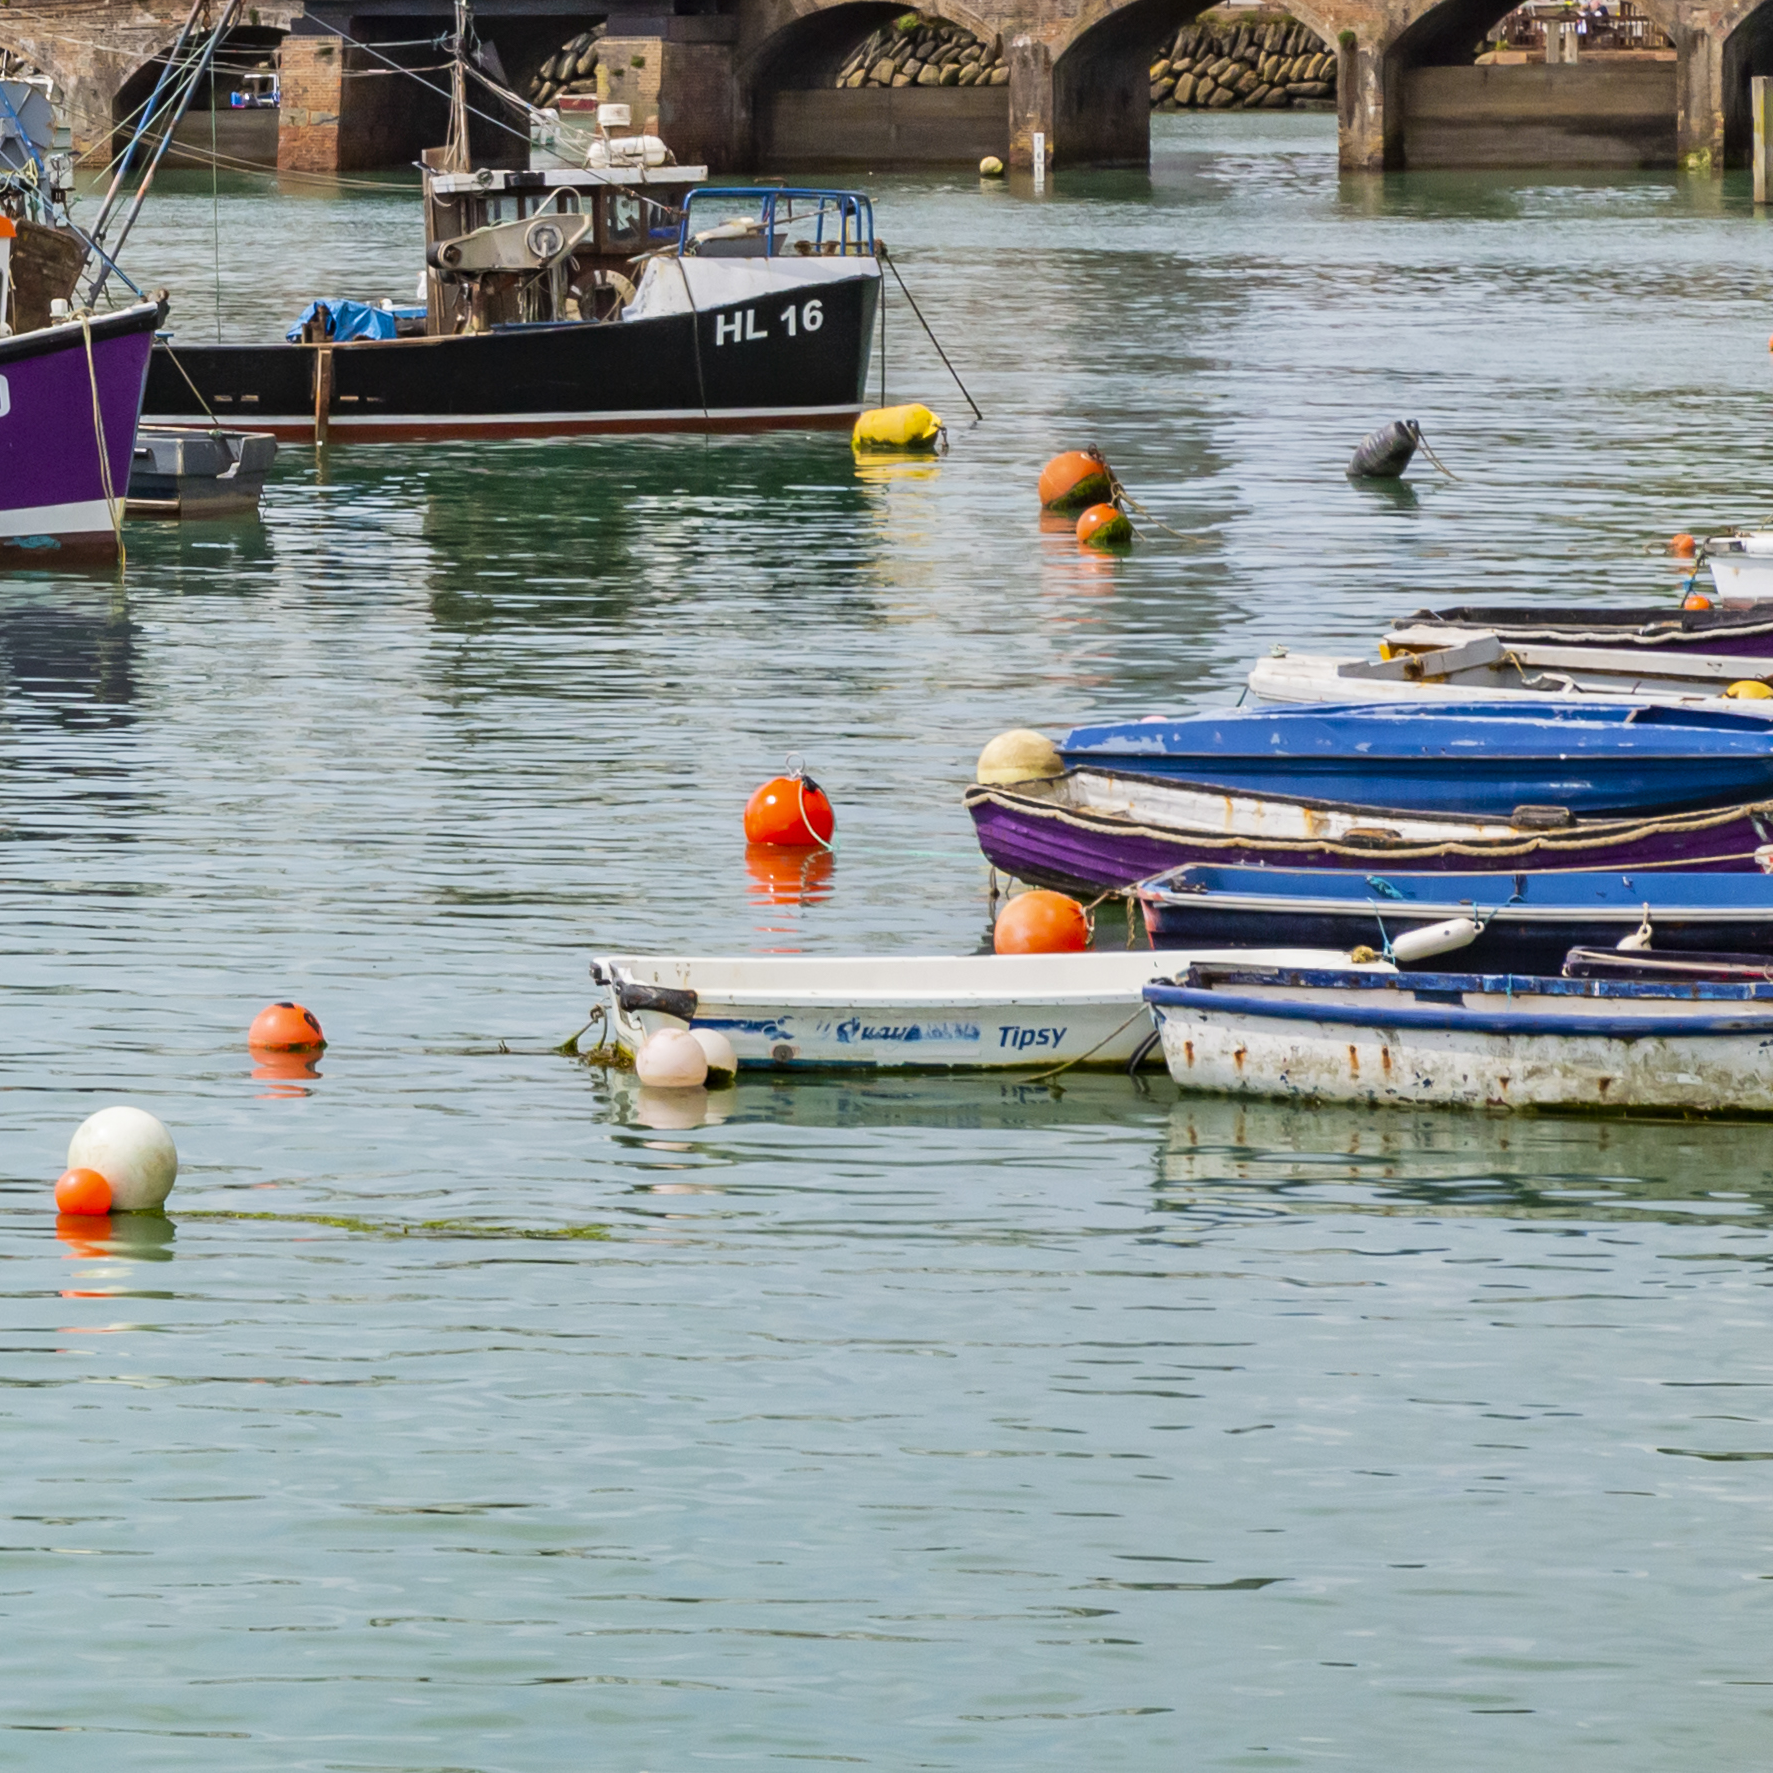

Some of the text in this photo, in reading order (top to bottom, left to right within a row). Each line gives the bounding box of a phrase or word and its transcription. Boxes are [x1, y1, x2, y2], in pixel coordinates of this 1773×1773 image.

[716, 299, 824, 346] HL 16
[998, 1026, 1068, 1051] Tipsy
